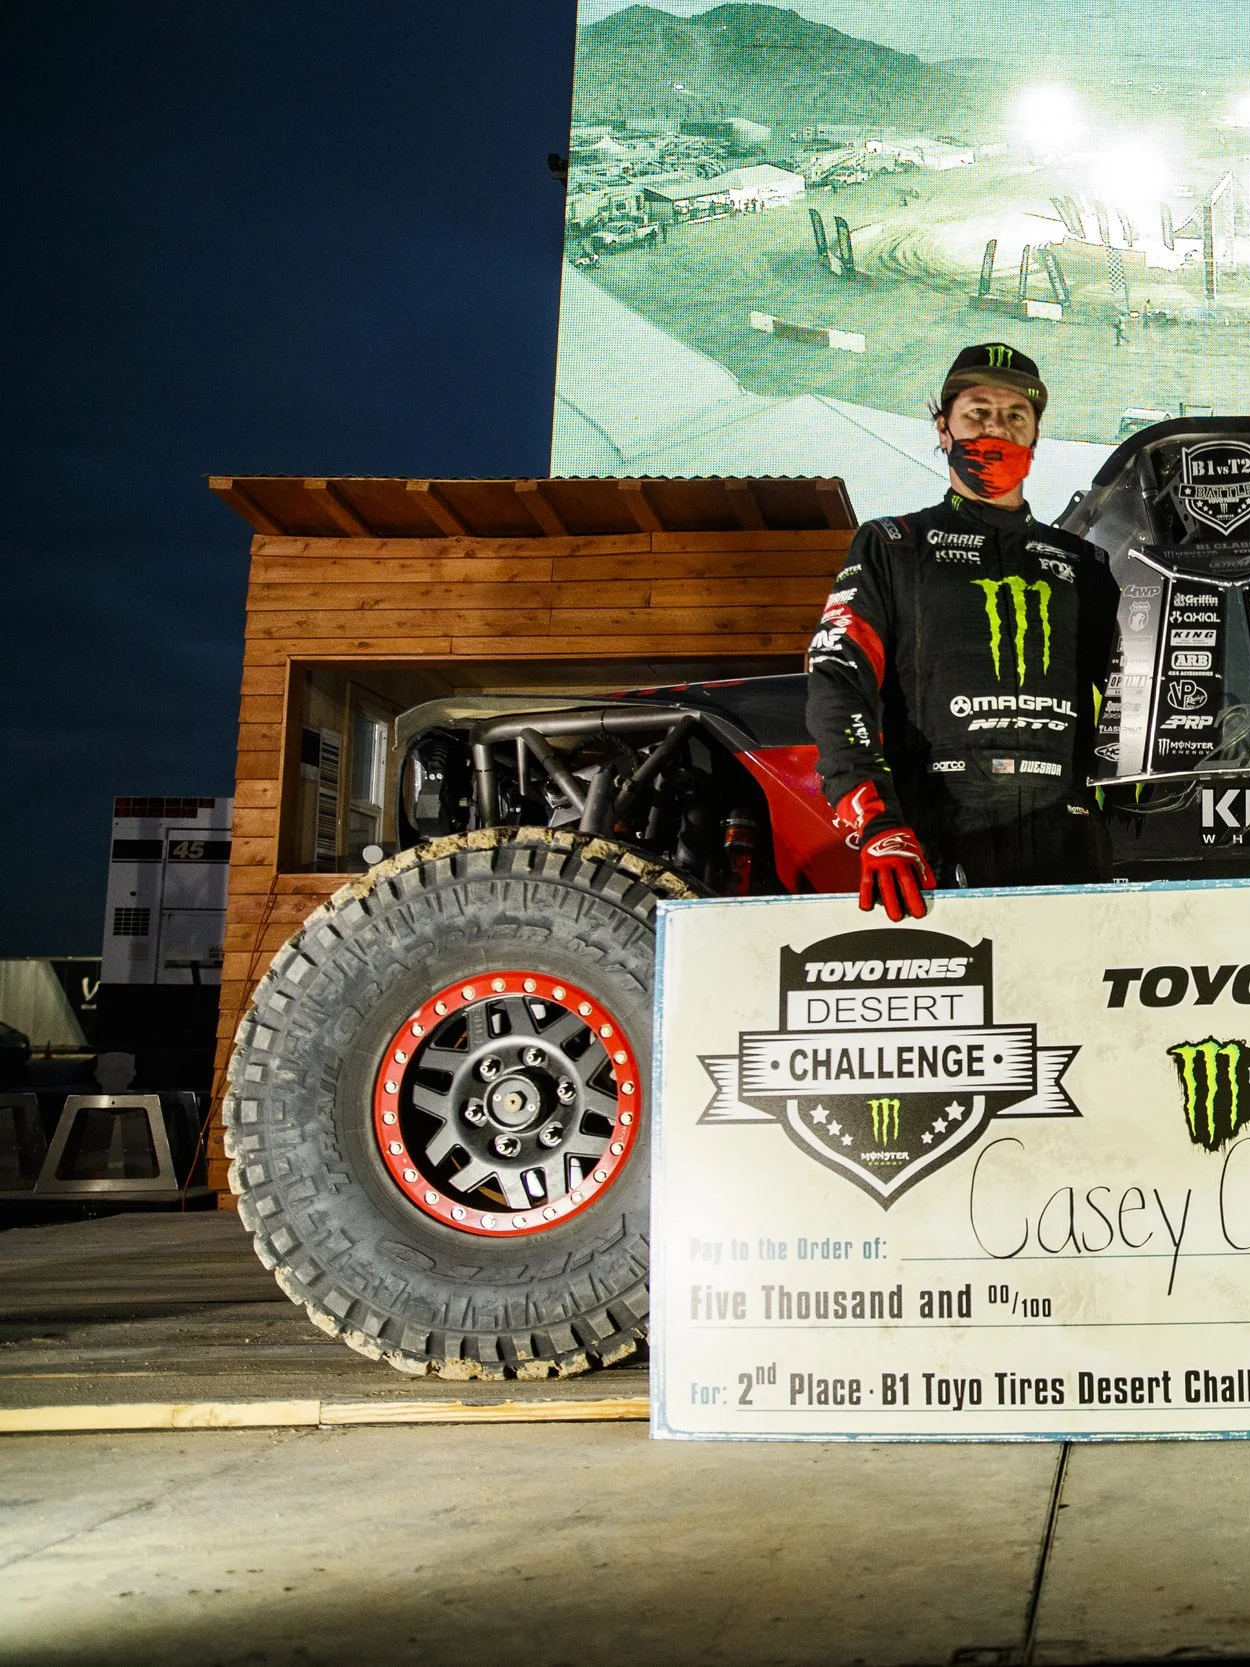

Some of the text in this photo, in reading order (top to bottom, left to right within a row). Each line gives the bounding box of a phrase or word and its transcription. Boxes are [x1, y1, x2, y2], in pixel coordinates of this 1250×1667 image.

[926, 529, 985, 545] CURRIE
[1038, 557, 1076, 584] FOX
[1123, 585, 1160, 598] 4WP
[1185, 594, 1218, 604] Griffin
[1173, 631, 1214, 639] KING
[1175, 656, 1208, 667] ARB
[1110, 676, 1146, 687] OPTIMA
[1169, 680, 1197, 709] VP
[972, 695, 1078, 718] MAGPUL
[967, 718, 1066, 731] NITTO
[1168, 715, 1214, 730] PRP
[1170, 740, 1214, 749] MONSTER
[931, 760, 1062, 776] parco QUESADA
[173, 841, 205, 859] 45
[807, 993, 963, 1024] DESERT
[789, 1043, 985, 1081] CHALLENGE
[861, 1150, 910, 1162] MONSTER
[970, 1137, 1192, 1296] Casey
[690, 1236, 888, 1263] Pay to the Order of:
[690, 1285, 747, 1321] Five
[760, 1283, 904, 1321] Thousand
[919, 1282, 973, 1319] and
[690, 1382, 728, 1406] For:
[738, 1362, 777, 1406] 2nd
[789, 1372, 862, 1406] Place
[881, 1372, 910, 1406] B1
[921, 1371, 983, 1411] Toyo
[995, 1370, 1066, 1405] Tires
[1078, 1369, 1172, 1404] Desert
